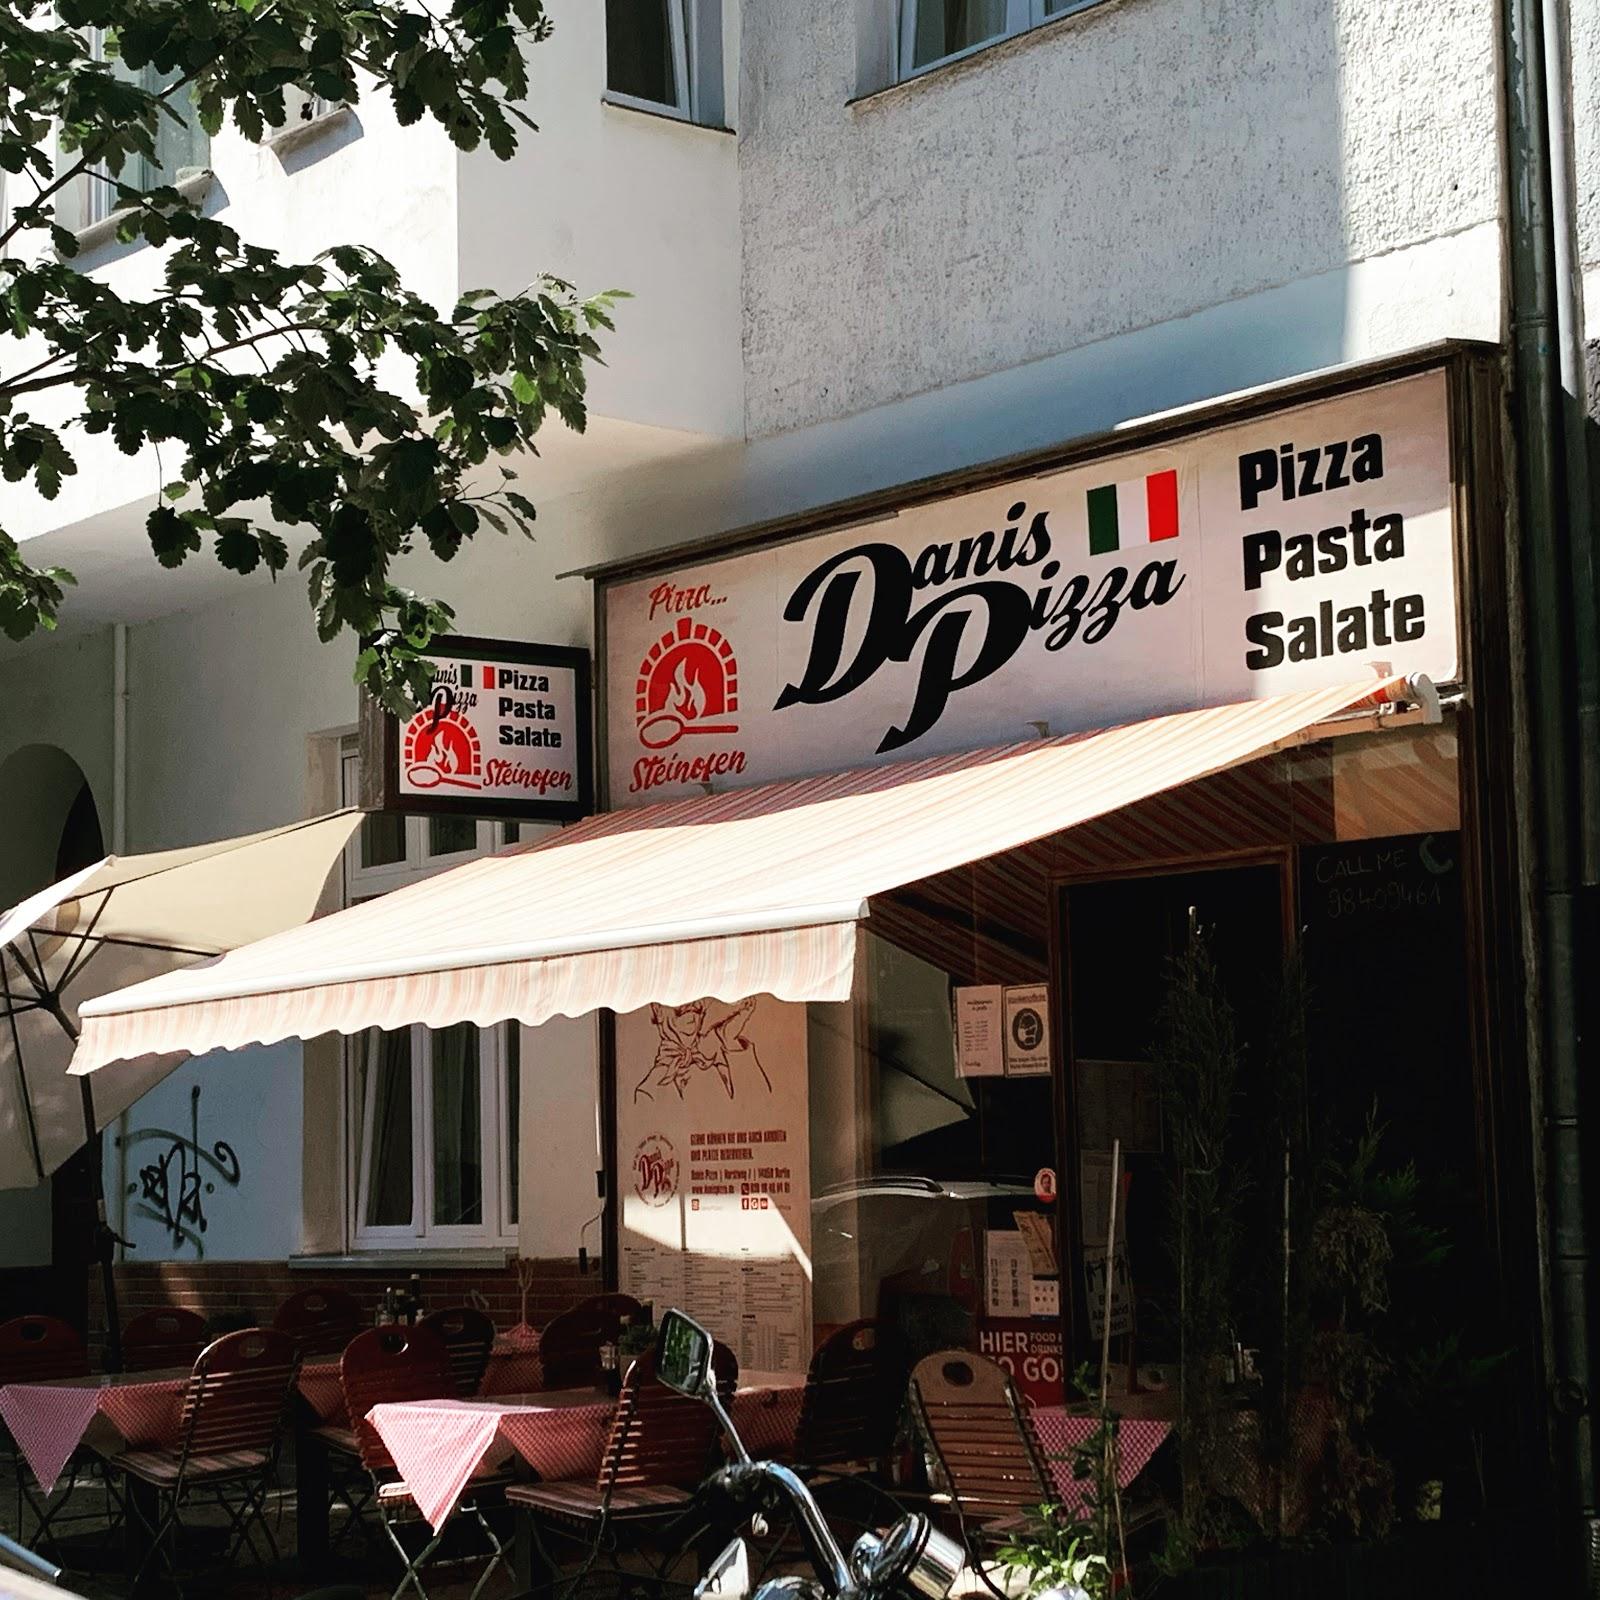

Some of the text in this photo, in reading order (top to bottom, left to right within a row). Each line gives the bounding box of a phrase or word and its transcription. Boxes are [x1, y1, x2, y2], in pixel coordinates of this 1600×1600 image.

[1238, 433, 1384, 511] Pizza
[1242, 508, 1405, 591] Pasta
[772, 501, 1052, 712] Danis
[1245, 589, 1426, 671] Salate
[875, 558, 1186, 754] Pizza
[498, 668, 549, 692] Pizza
[498, 697, 556, 720] Pasta
[499, 725, 562, 748] Salate
[482, 758, 572, 795] Steinofen
[629, 750, 747, 793] Steinofen
[1315, 855, 1375, 883] CALL
[980, 1331, 1028, 1353] HIER
[1030, 1332, 1056, 1342] FOOD
